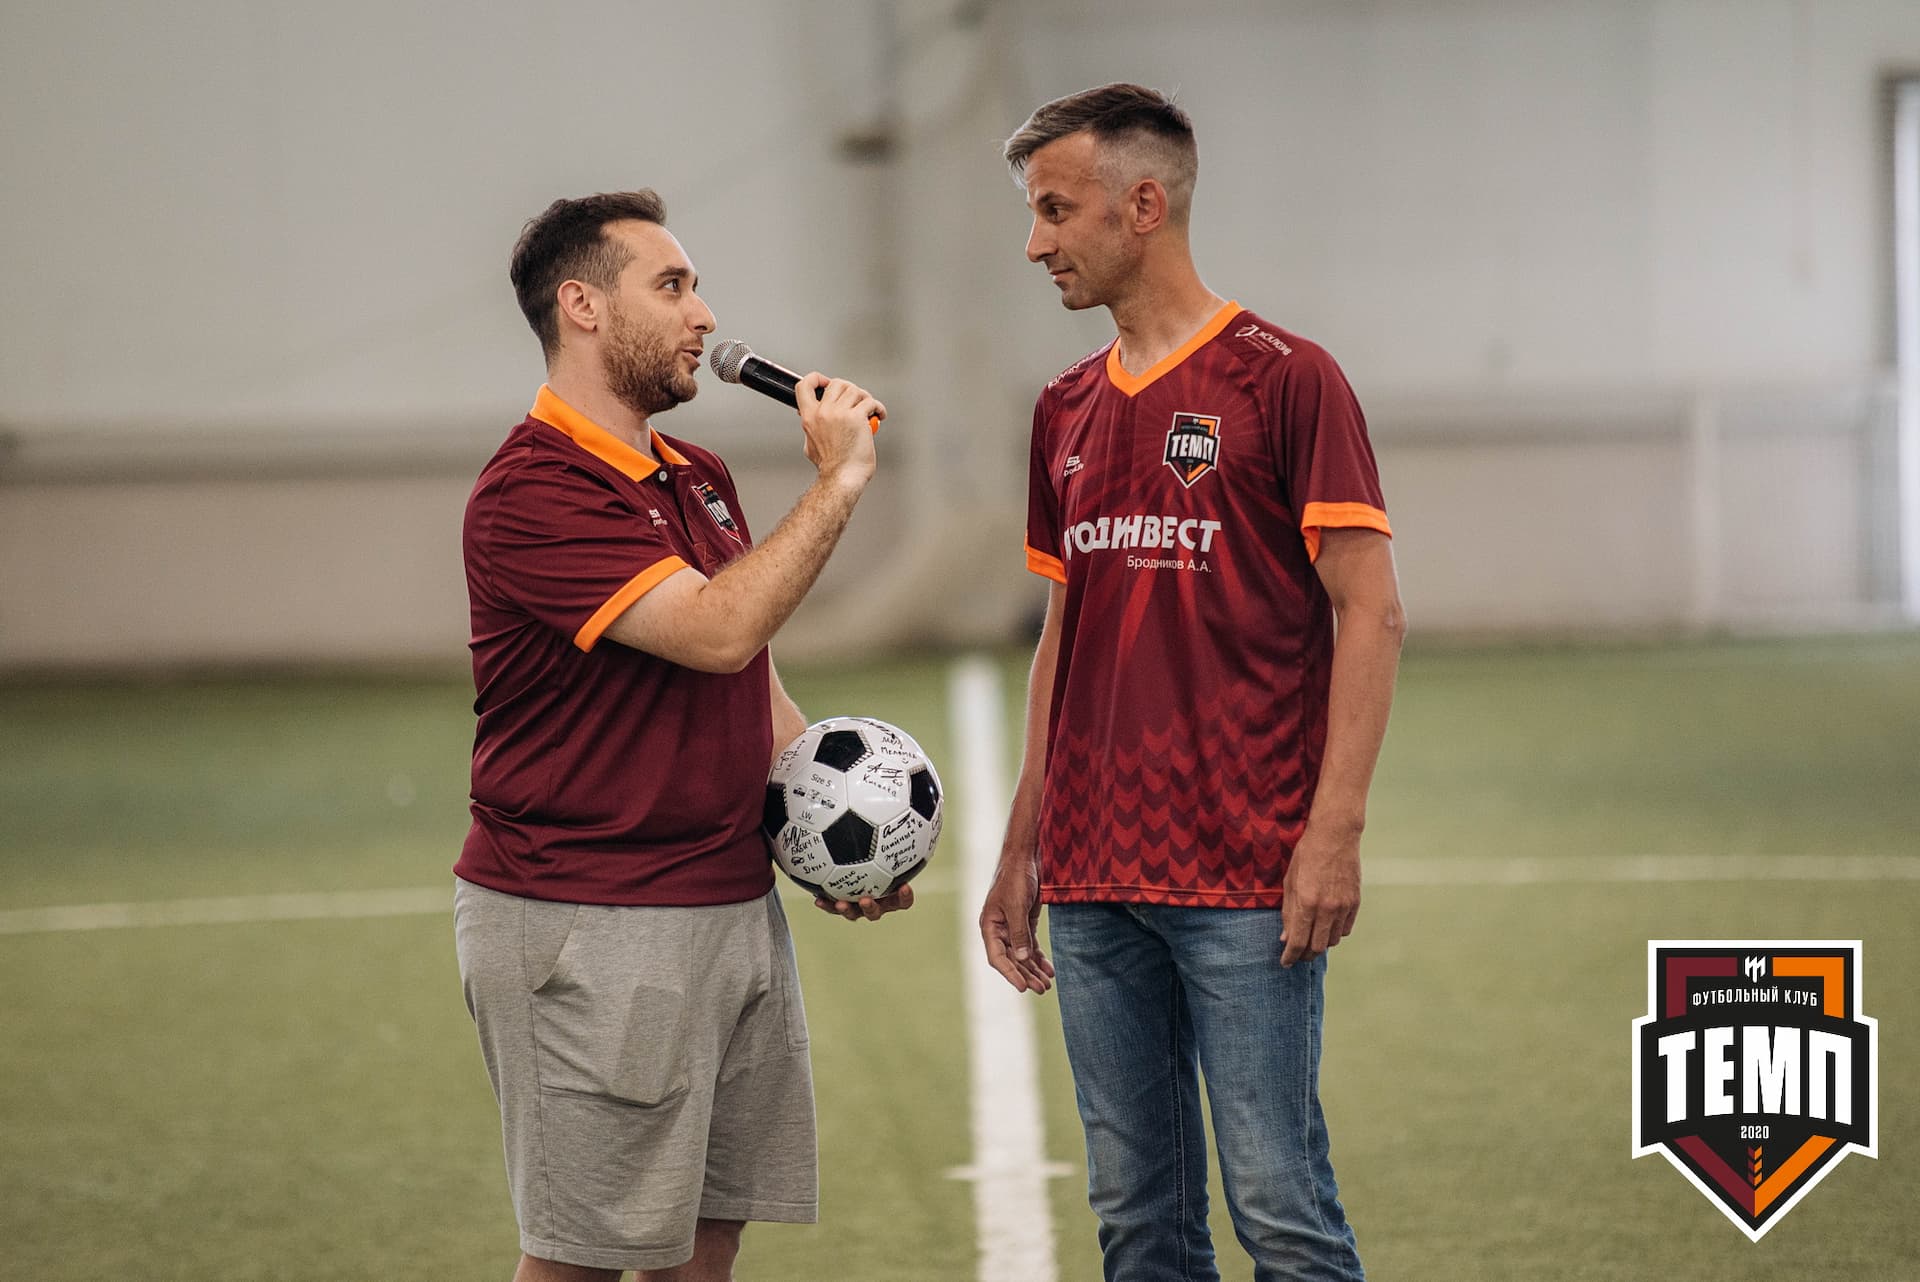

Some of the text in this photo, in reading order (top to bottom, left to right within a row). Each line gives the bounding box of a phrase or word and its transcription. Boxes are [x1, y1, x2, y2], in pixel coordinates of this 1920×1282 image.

[1171, 434, 1215, 462] ТЕМП
[1127, 555, 1212, 573] Бродников А.А.
[811, 773, 833, 787] Size 5
